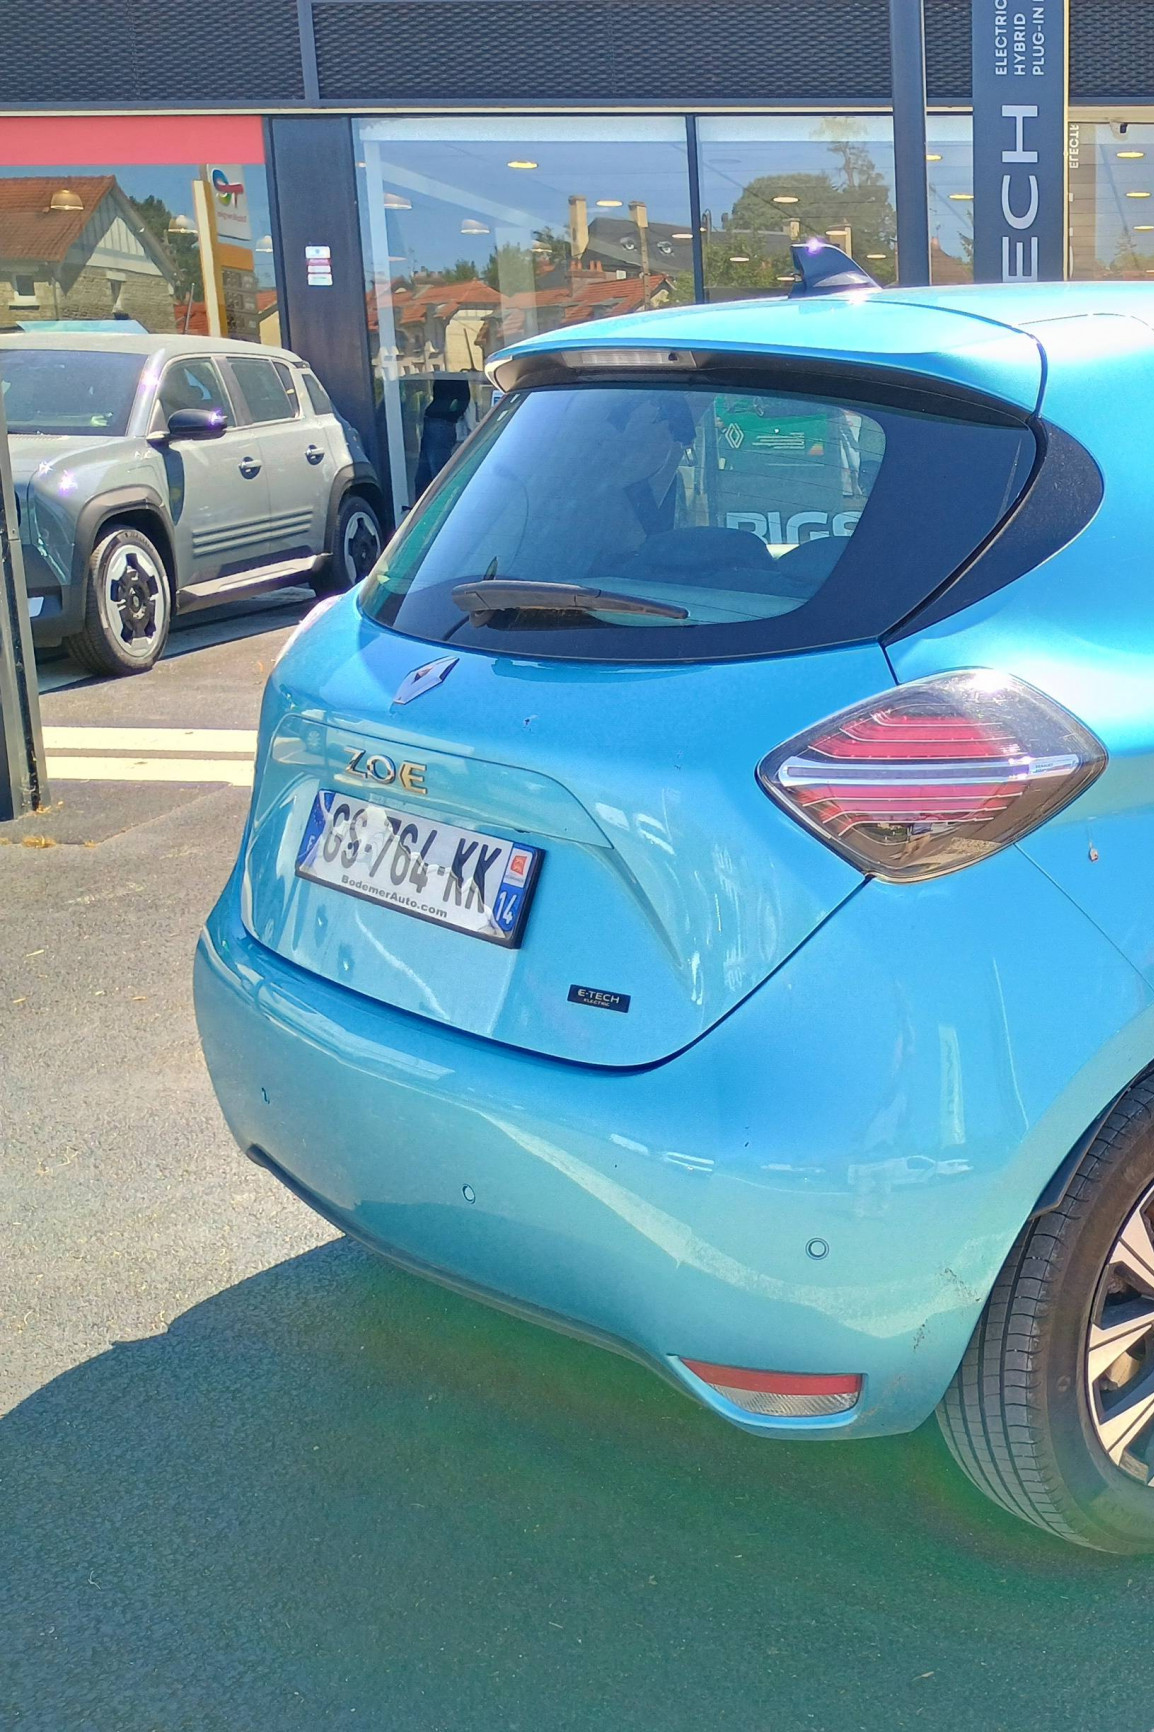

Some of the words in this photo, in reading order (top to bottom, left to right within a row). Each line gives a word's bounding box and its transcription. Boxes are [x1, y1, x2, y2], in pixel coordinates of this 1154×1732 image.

[995, 0, 1007, 75] ELECTRIC
[1014, 13, 1026, 75] HYBRID
[1032, 7, 1045, 75] PLUG-IN
[344, 745, 428, 795] ZOE
[322, 802, 502, 914] GS-764-KK
[341, 873, 449, 919] BodemerAuto.com
[495, 891, 517, 925] 14
[577, 988, 620, 1004] E-TECH
